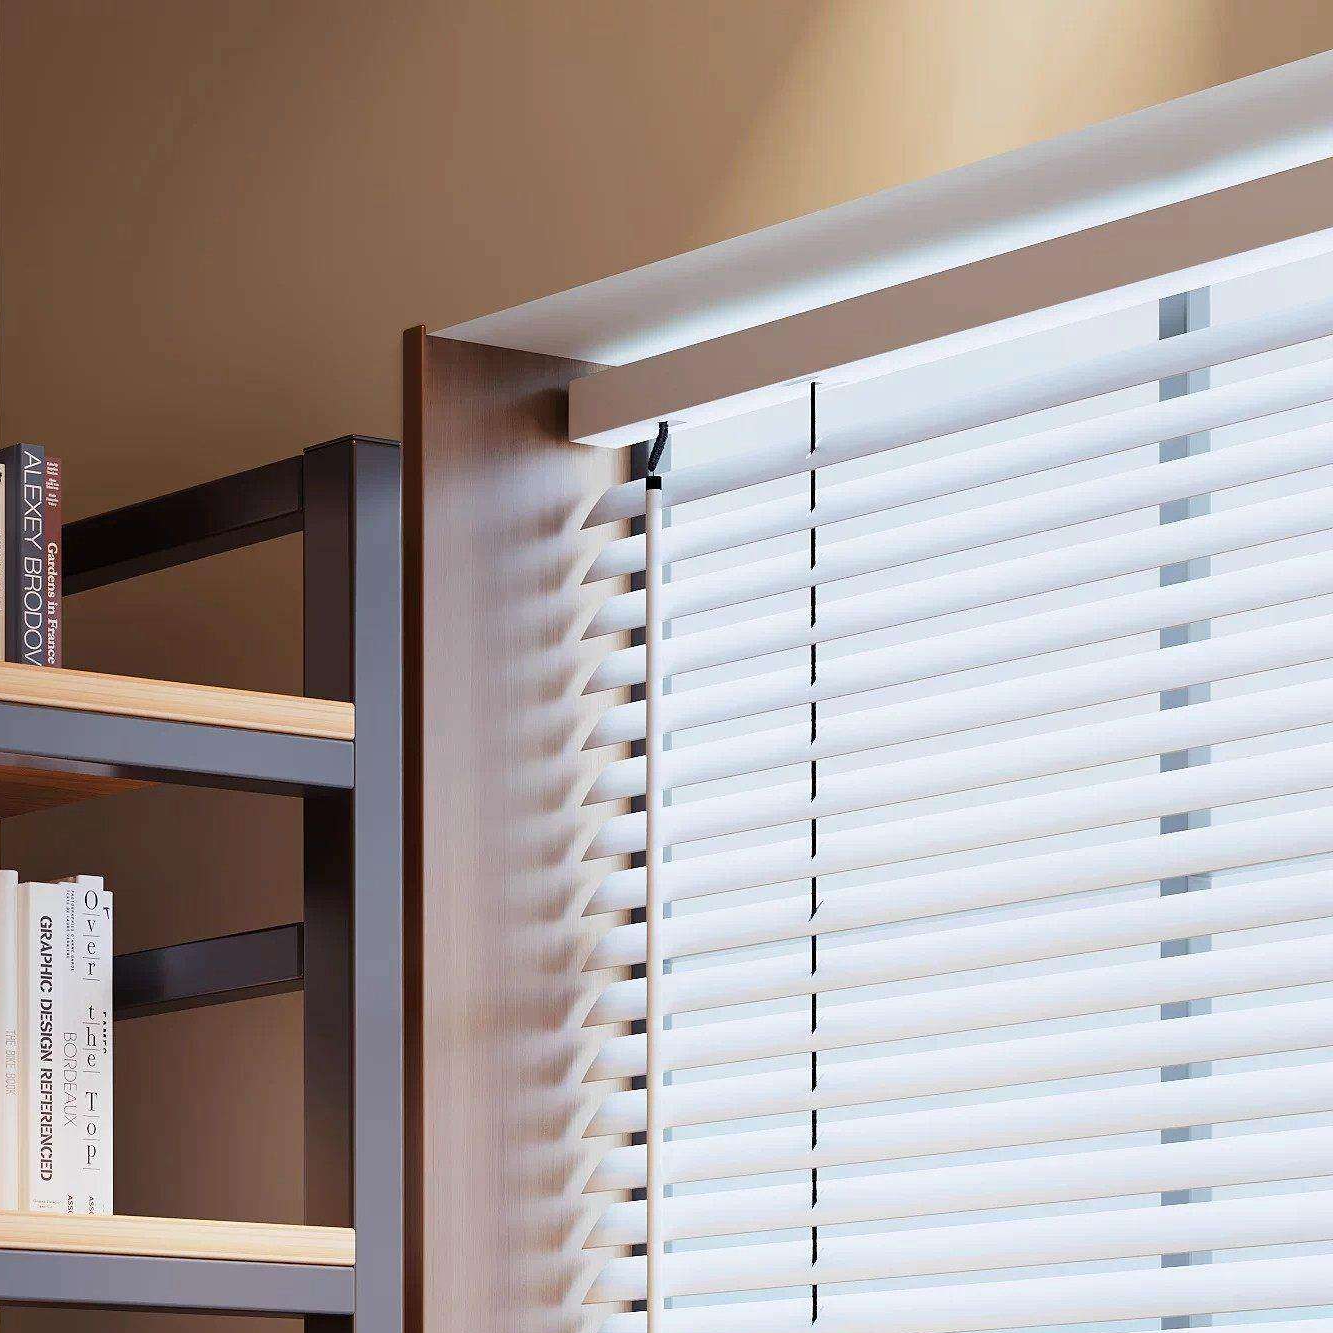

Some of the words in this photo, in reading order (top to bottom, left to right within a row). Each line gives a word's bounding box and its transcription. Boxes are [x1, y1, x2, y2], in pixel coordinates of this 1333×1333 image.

[47, 542, 58, 599] Gardens
[48, 602, 57, 613] in
[47, 616, 58, 664] France
[39, 915, 53, 992] GRAPHIC
[39, 999, 53, 1062] DESIGN
[40, 1068, 53, 1181] REFERENCED
